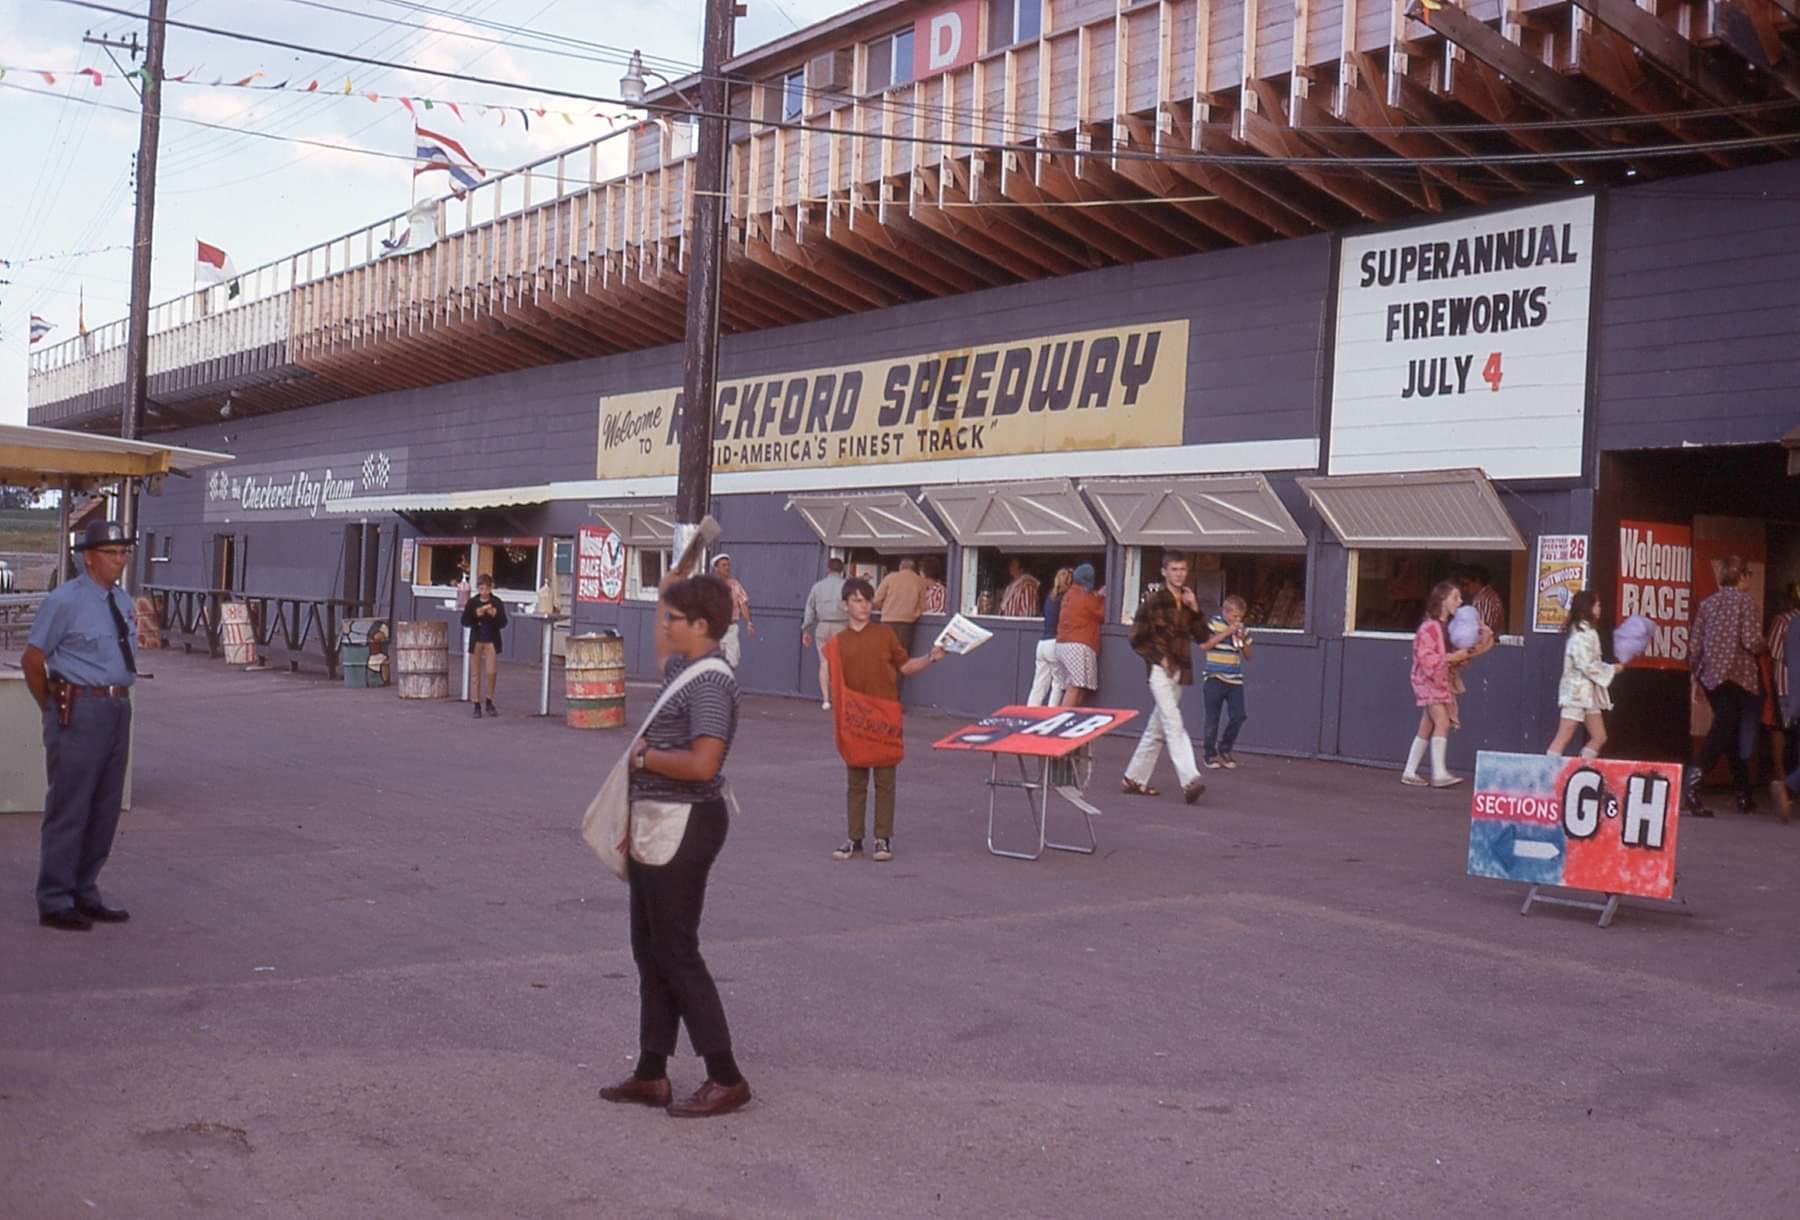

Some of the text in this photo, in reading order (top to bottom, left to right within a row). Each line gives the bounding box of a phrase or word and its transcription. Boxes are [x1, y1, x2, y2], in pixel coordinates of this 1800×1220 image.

[929, 11, 962, 70] D
[1360, 223, 1577, 287] SUPERANNUAL
[1386, 286, 1548, 342] FIREWORKS
[666, 331, 1161, 446] RCKFORD SPEEDWAY
[1401, 351, 1503, 398] JULY 4
[603, 405, 663, 449] Welcome
[639, 438, 652, 455] TO
[711, 435, 827, 467] ID-AMERICA'S
[838, 433, 904, 459] FINEST
[242, 475, 295, 509] Checkered
[295, 471, 321, 517] Flag
[321, 469, 354, 505] Room
[1570, 538, 1585, 560] 26
[1620, 527, 1692, 583] Welcom
[1621, 583, 1690, 620] RACE
[1021, 711, 1076, 736] A
[1058, 714, 1114, 738] B
[1475, 768, 1669, 849] SECTIONS G & H
